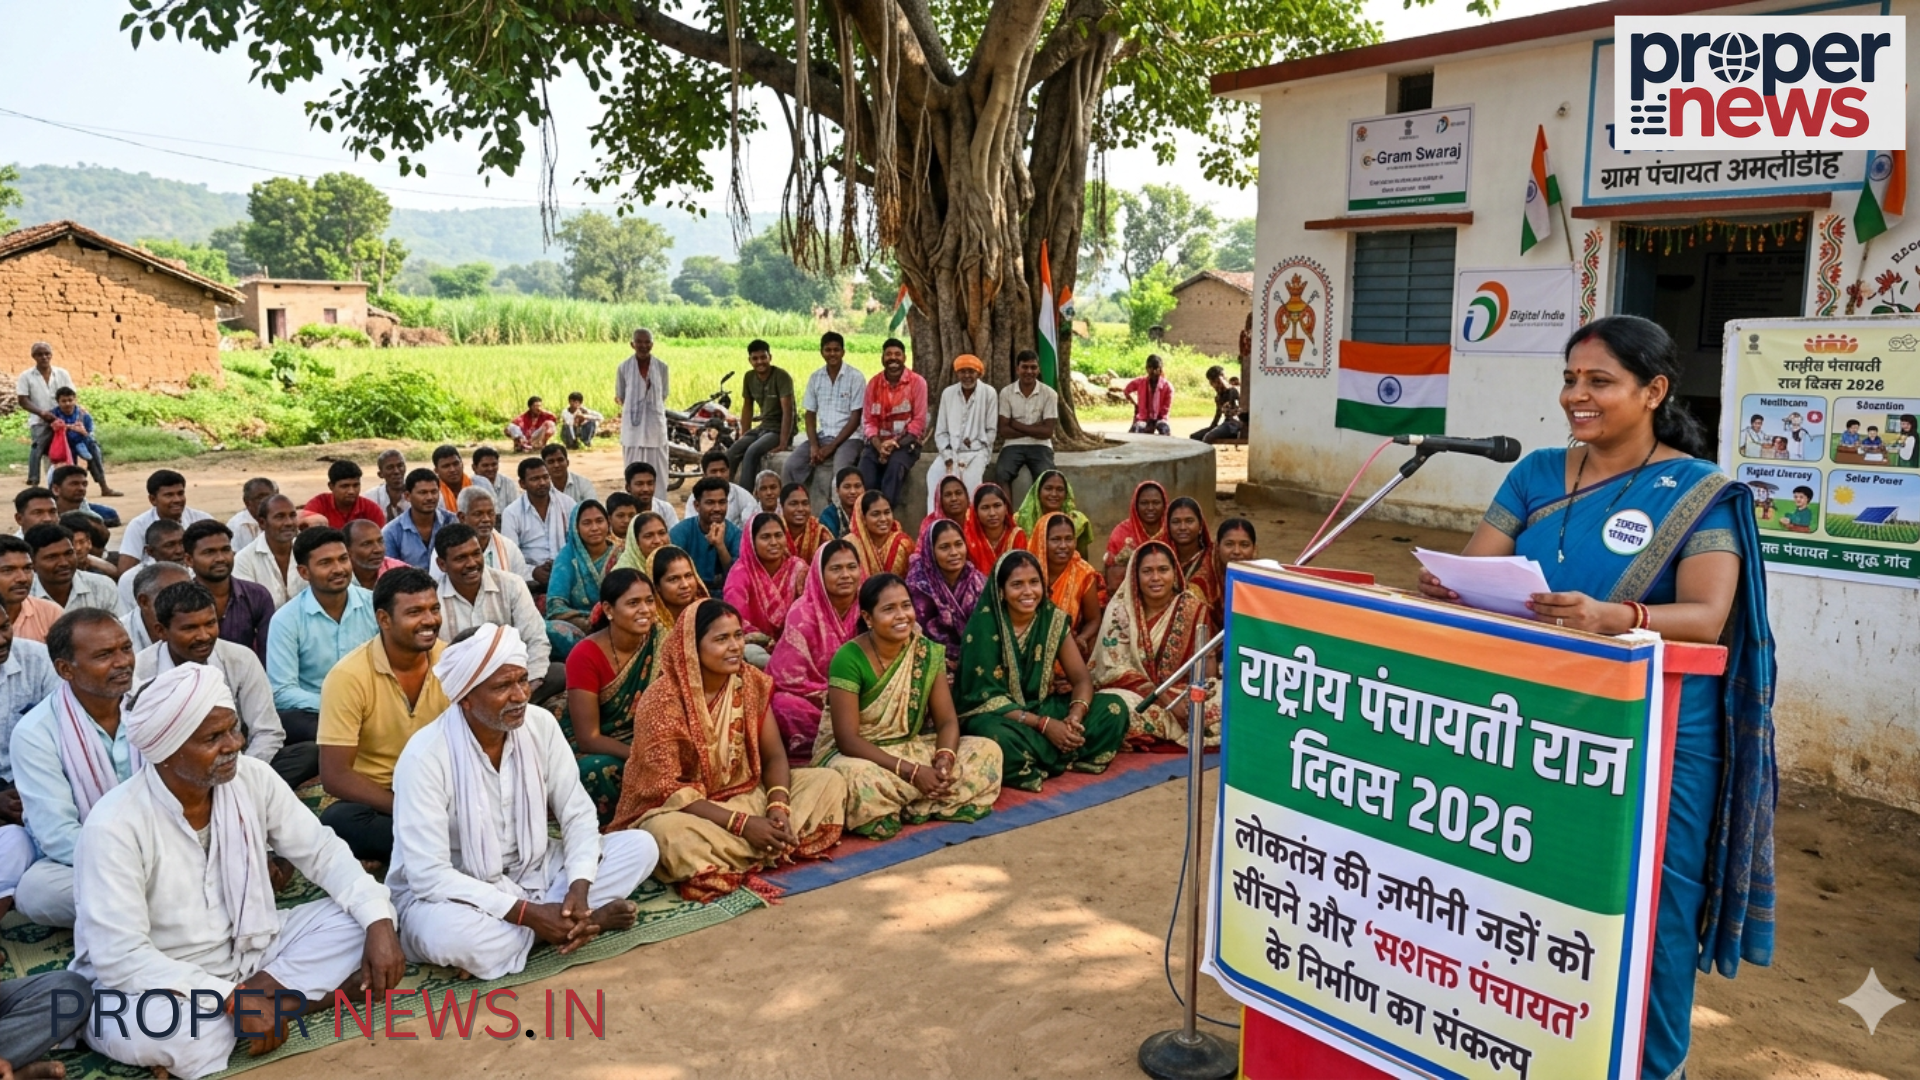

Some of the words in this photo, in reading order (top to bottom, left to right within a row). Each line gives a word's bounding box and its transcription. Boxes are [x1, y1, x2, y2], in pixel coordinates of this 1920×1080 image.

[1416, 142, 1462, 161] Swaraj
[1601, 167, 1642, 190] ग्राम
[1646, 159, 1722, 187] पंचायत
[1727, 150, 1843, 181] अमलीडीह
[1238, 645, 1352, 722] राष्ट्रीय
[1358, 666, 1524, 770] पंचायती
[1530, 719, 1634, 796] राज
[1290, 728, 1401, 821] दिवस
[1408, 775, 1534, 864] 2026
[1233, 866, 1301, 925] सींचने
[1307, 895, 1357, 947] और
[1235, 814, 1327, 881] लोकतंत्र
[1333, 851, 1371, 898] की
[1377, 873, 1469, 936] ज़मीनी
[1475, 908, 1541, 965] जड़ों
[1547, 930, 1595, 981] को
[1265, 927, 1291, 970] के
[1297, 944, 1380, 1014] निर्माण
[1386, 989, 1426, 1035] का
[1433, 1008, 1532, 1080] संकल्प
